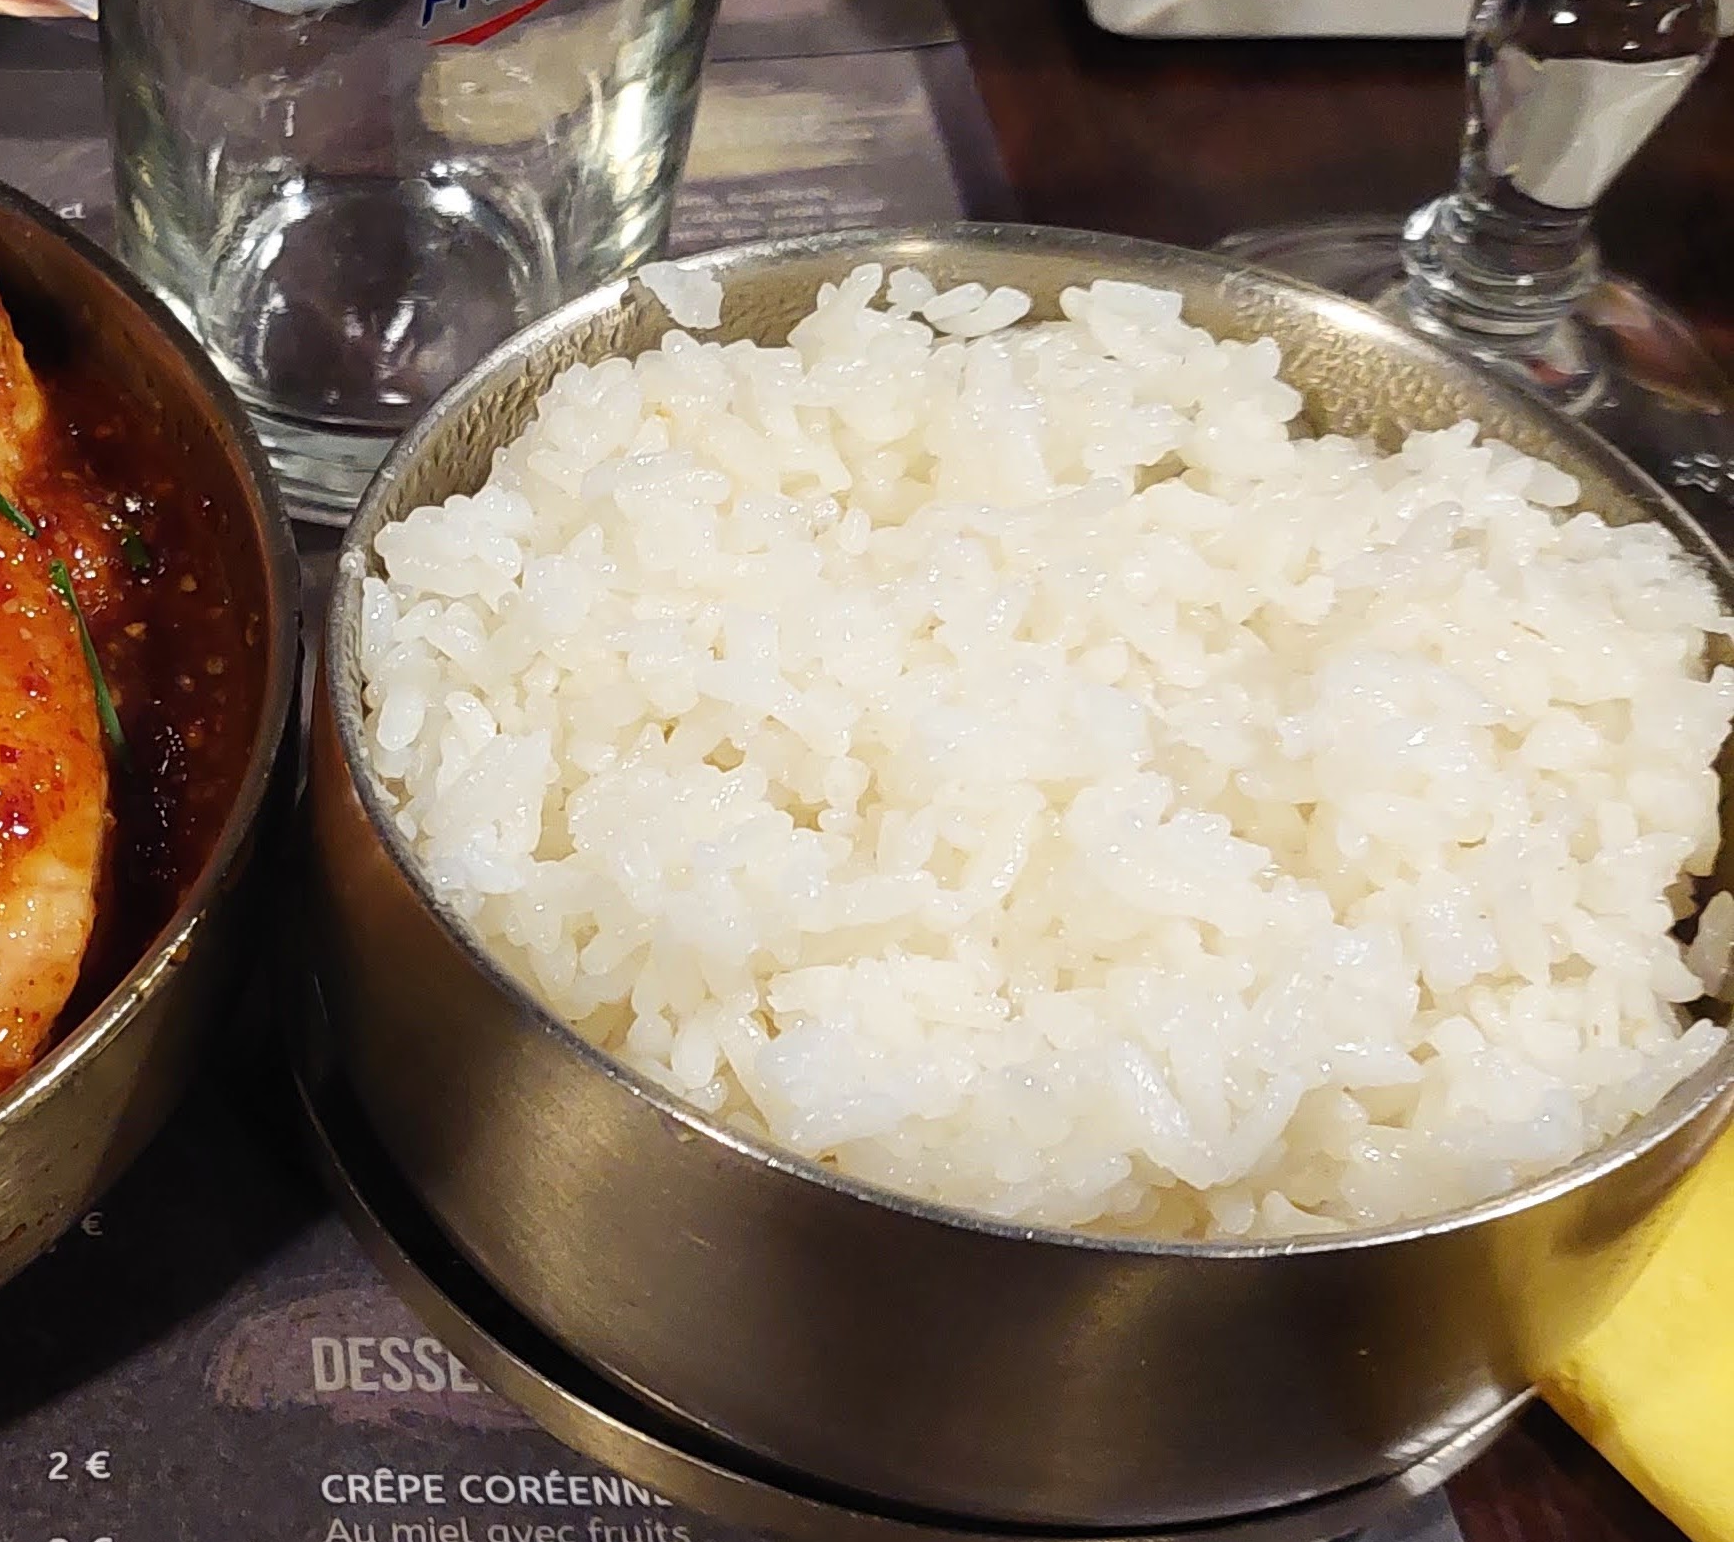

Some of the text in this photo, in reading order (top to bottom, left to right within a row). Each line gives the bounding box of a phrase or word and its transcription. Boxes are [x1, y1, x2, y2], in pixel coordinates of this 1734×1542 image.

[311, 1336, 494, 1394] DESSE
[48, 1451, 111, 1480] 2 €
[321, 1467, 674, 1506] CRÊPE CORÉENN
